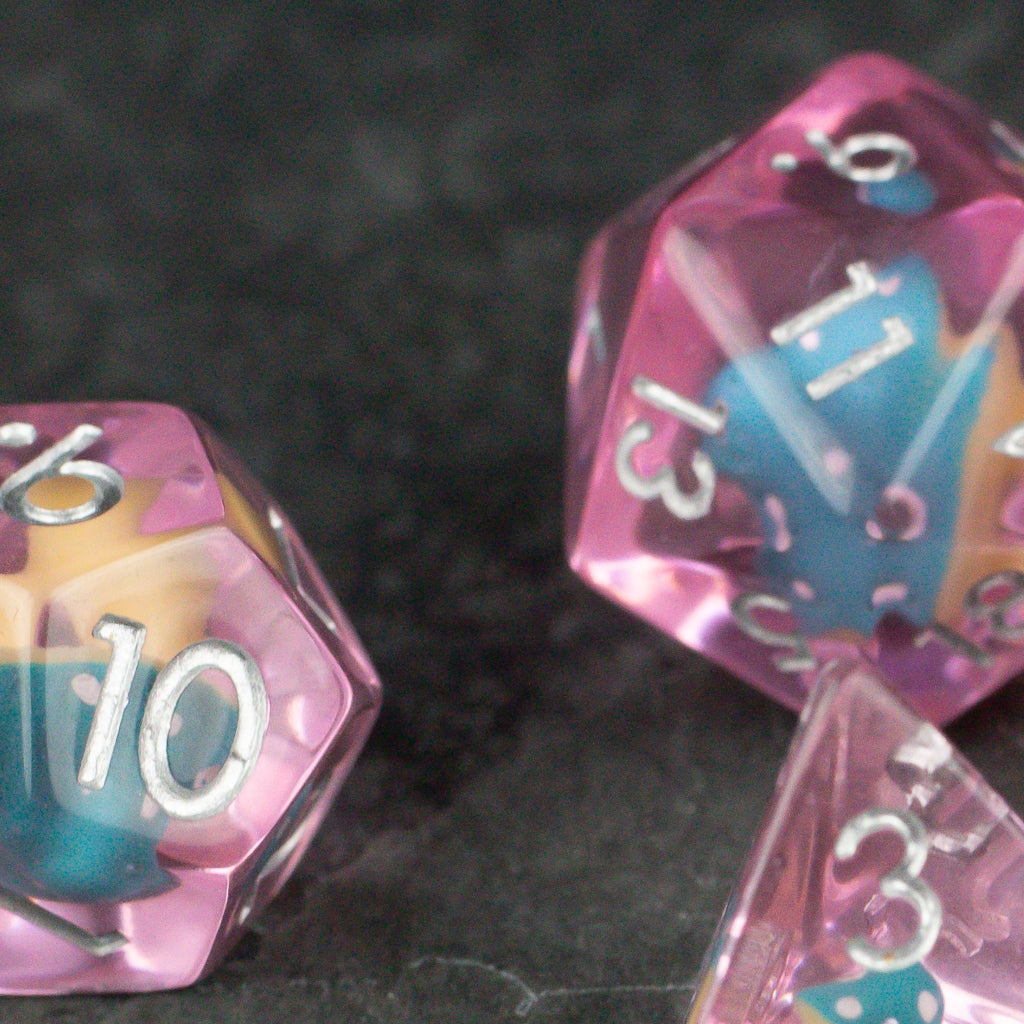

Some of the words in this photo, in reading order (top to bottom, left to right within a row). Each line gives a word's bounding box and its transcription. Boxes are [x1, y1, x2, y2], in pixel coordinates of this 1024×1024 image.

[769, 262, 915, 401] 11
[614, 373, 729, 521] 13
[77, 613, 270, 822] 10
[834, 809, 942, 969] 3
